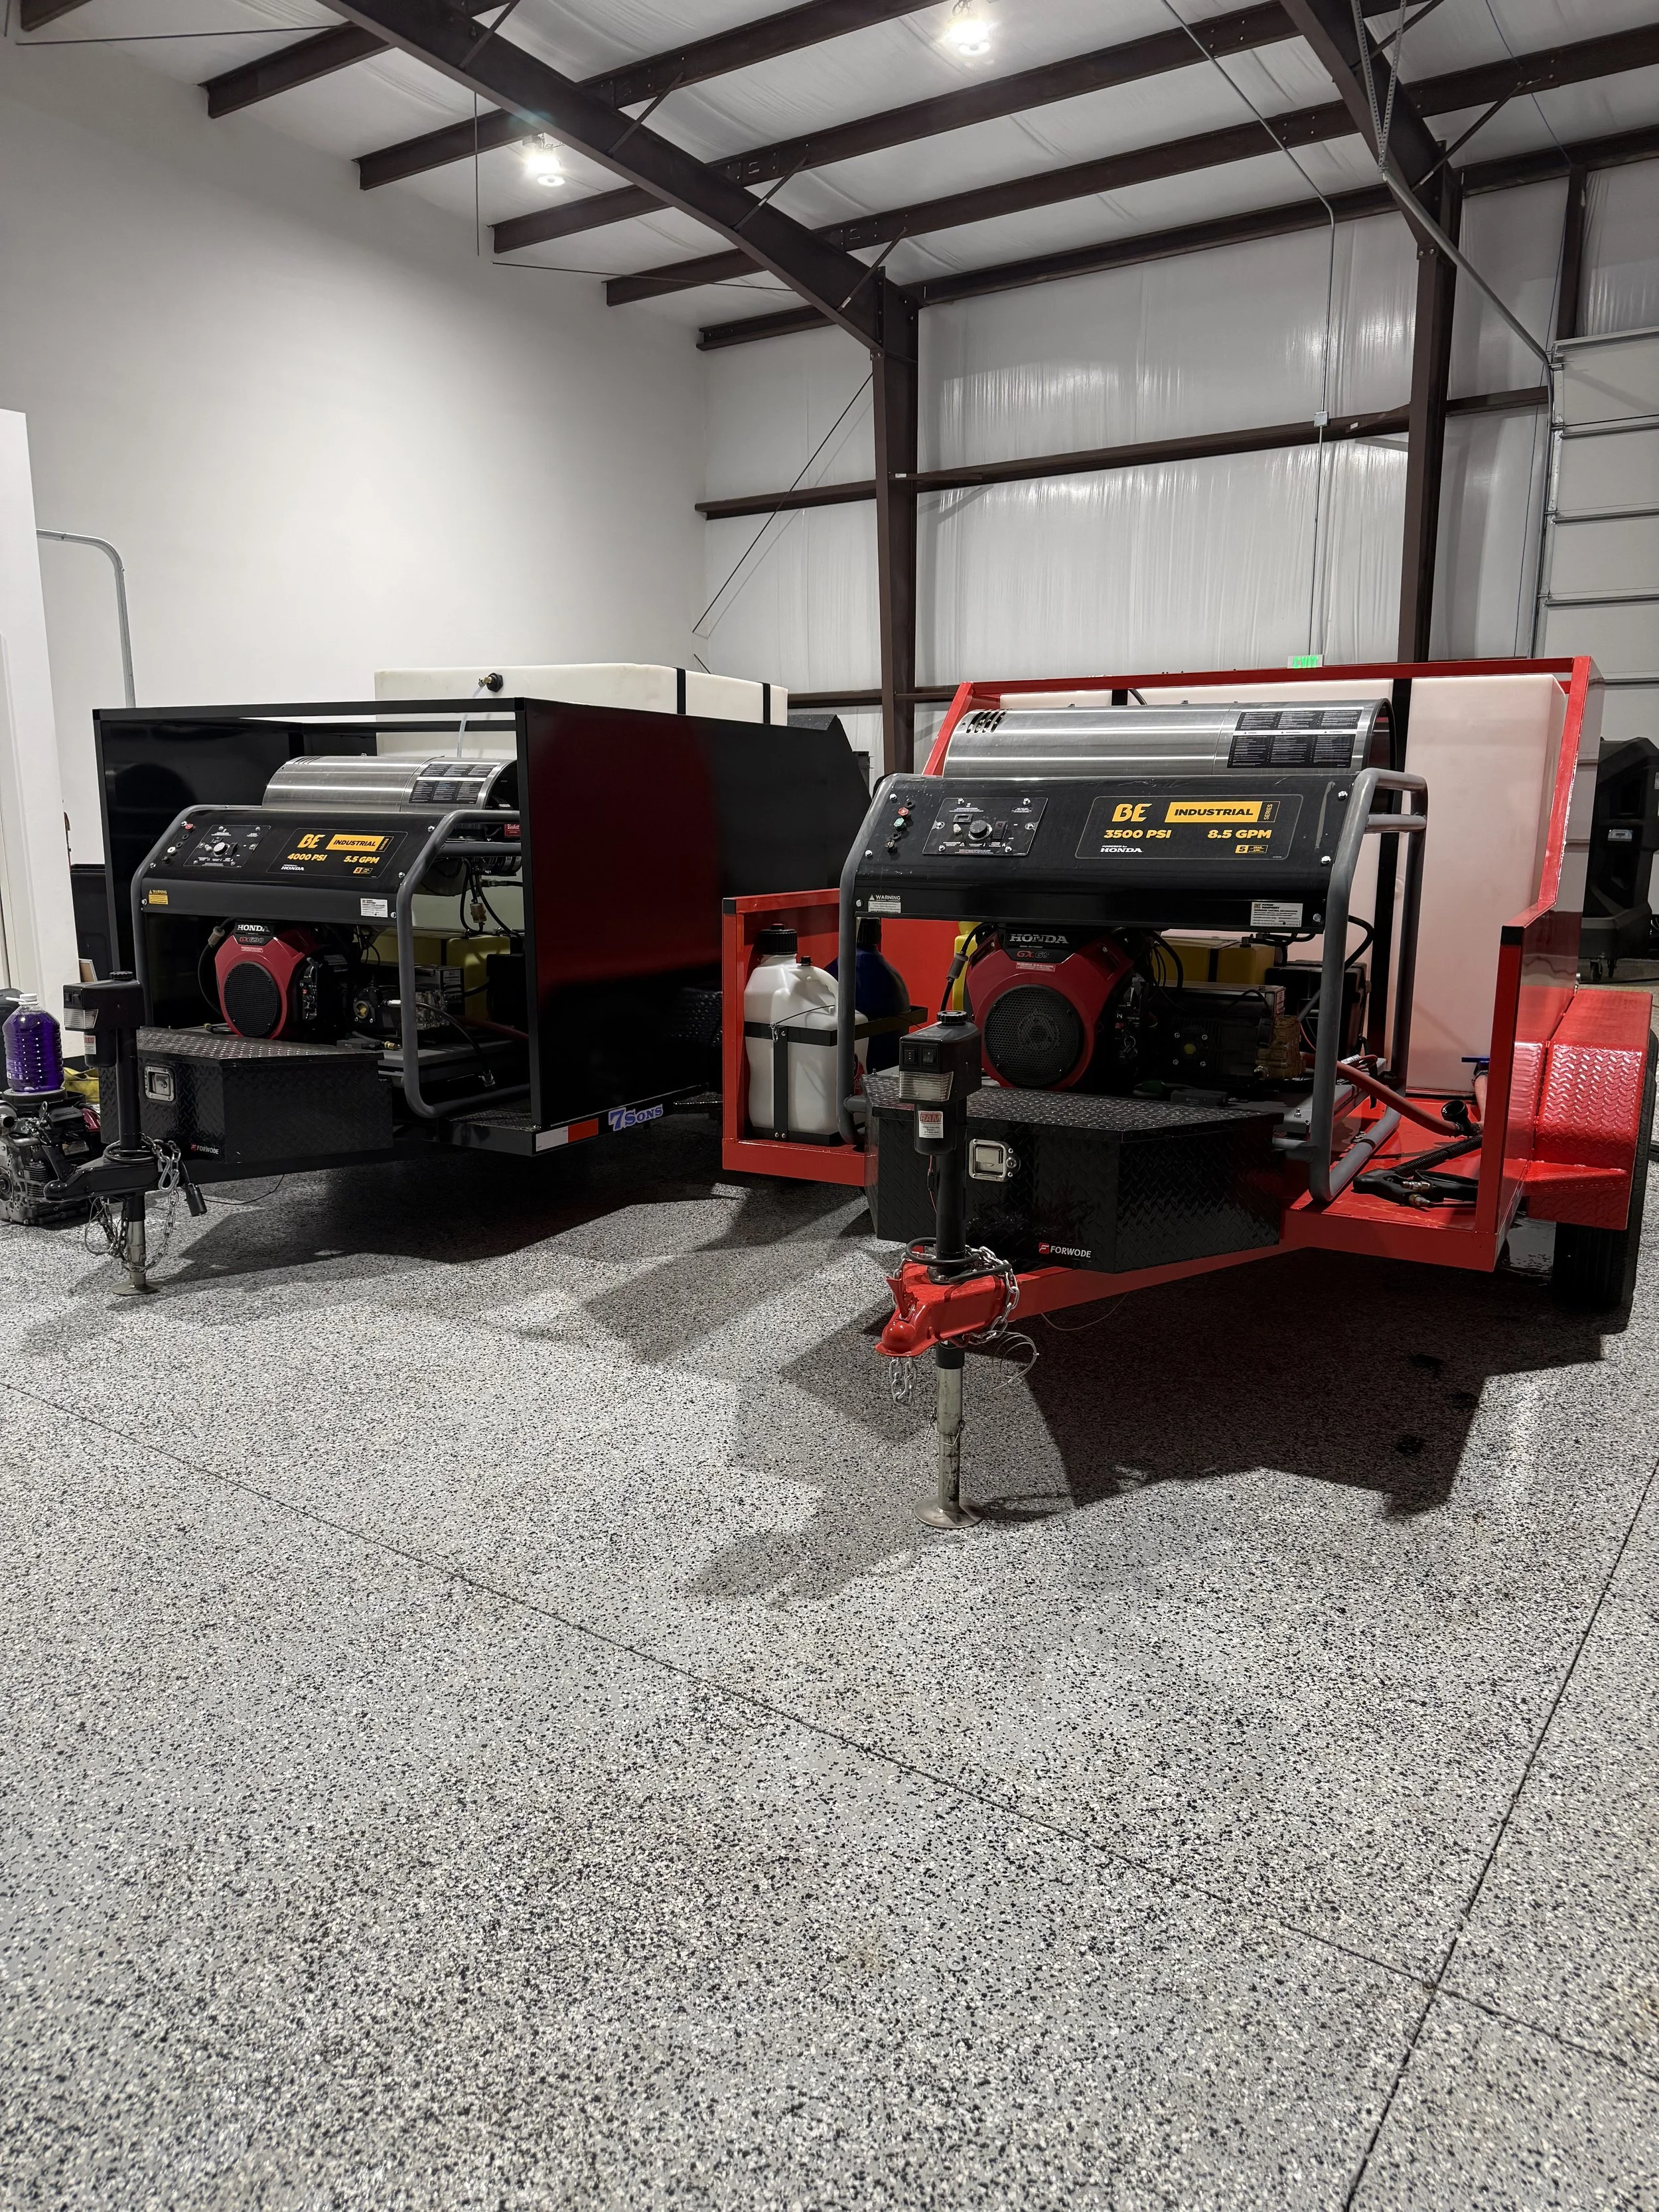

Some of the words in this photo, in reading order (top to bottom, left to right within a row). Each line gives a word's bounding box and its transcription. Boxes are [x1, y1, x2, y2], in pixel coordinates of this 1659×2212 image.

[1112, 803, 1152, 822] BE
[1263, 804, 1273, 820] SERIES
[1104, 830, 1143, 839] 3500
[1145, 830, 1172, 839] PSI
[1207, 830, 1232, 839] 8.5
[1235, 830, 1272, 839] GPM
[297, 834, 326, 849] BE
[1009, 934, 1068, 944] HONDA
[196, 1145, 219, 1155] FORWODE
[1050, 1246, 1092, 1258] FORWODE
